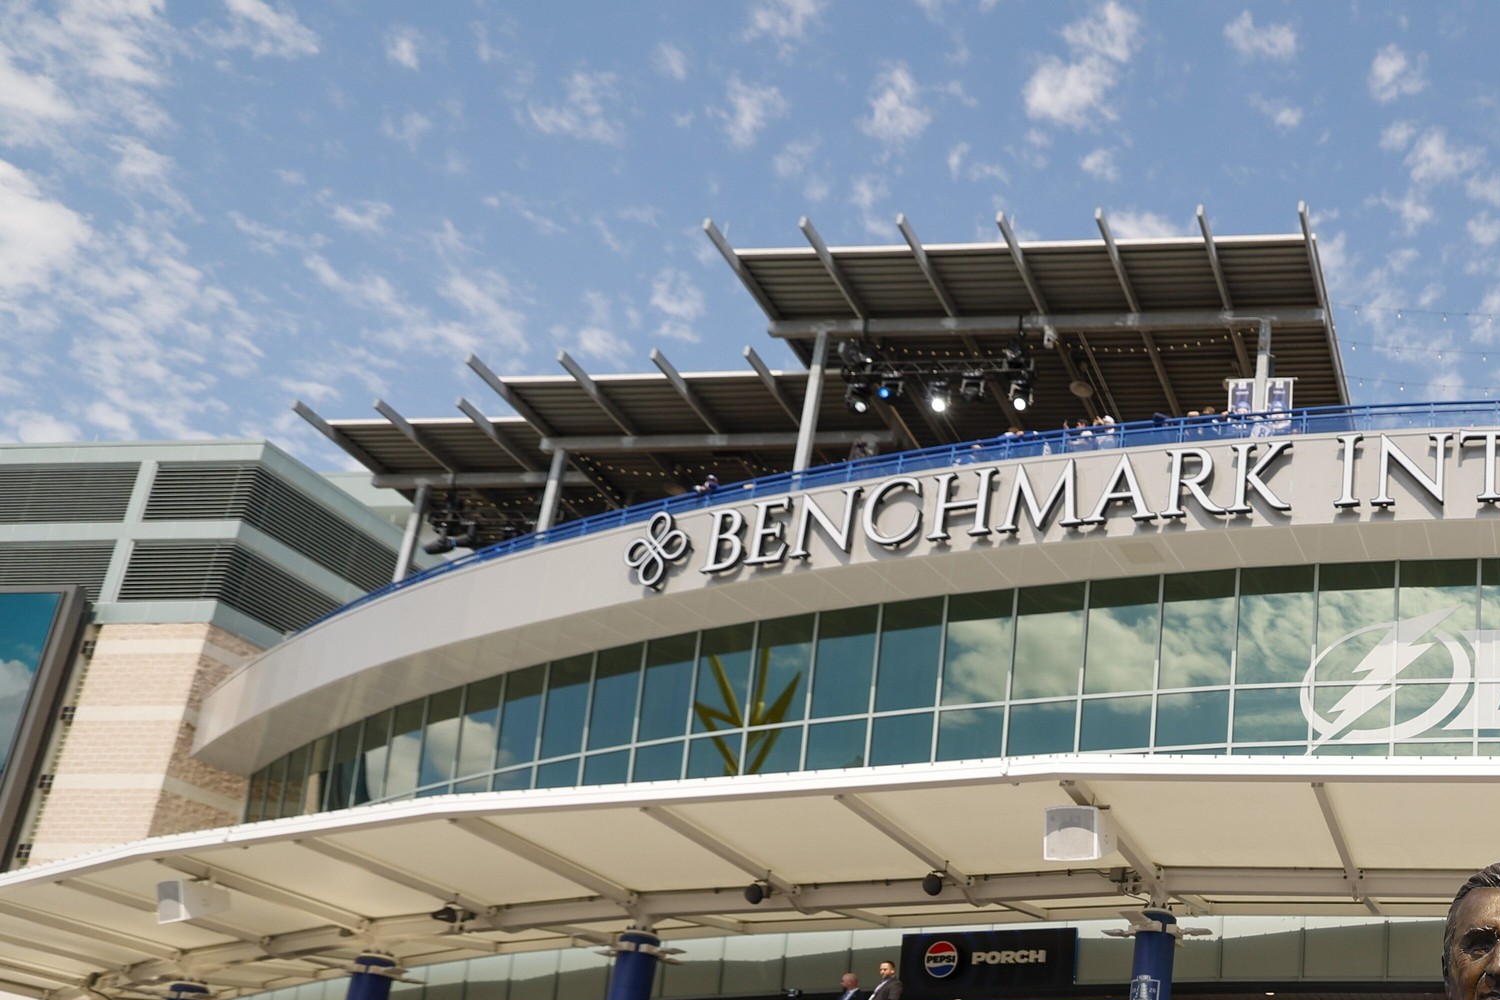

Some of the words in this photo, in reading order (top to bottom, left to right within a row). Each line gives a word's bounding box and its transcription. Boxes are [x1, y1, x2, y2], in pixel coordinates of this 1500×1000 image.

[700, 441, 1294, 574] BENCHMARK
[926, 954, 956, 964] PEPSI
[971, 950, 1047, 965] PORCH
